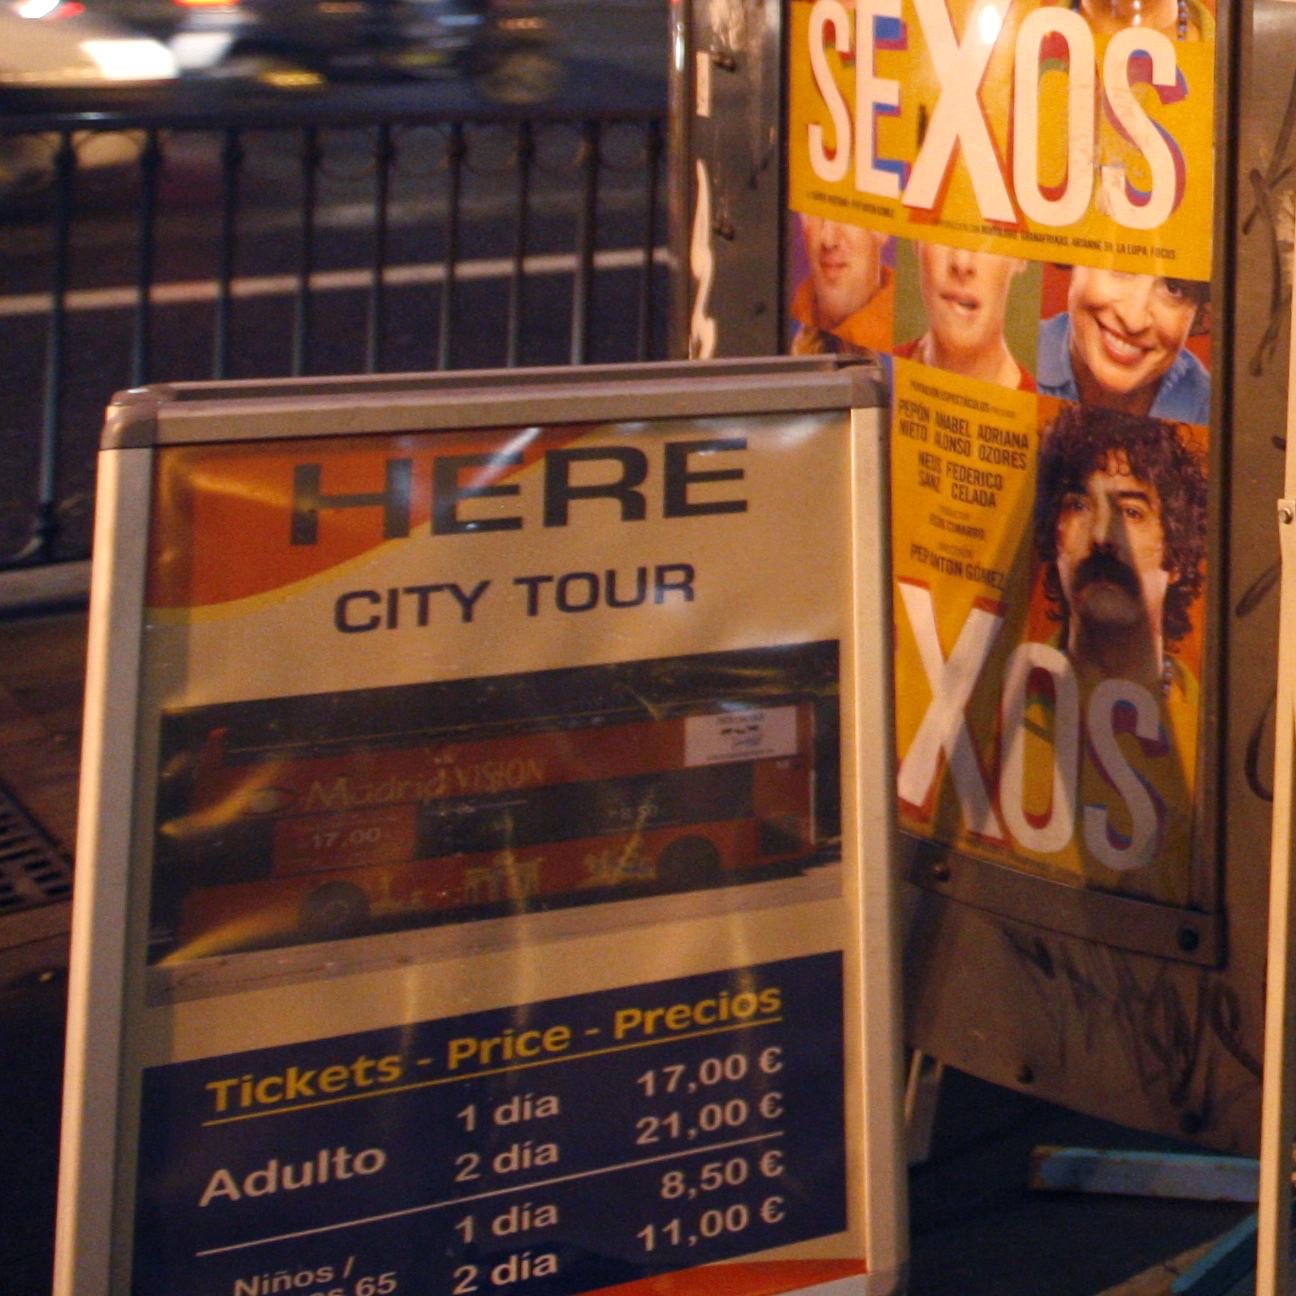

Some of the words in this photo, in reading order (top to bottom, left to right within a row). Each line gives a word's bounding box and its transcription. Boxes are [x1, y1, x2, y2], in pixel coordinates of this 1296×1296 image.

[899, 418, 929, 443] NIETO
[934, 430, 972, 458] ALONSO
[978, 443, 1028, 471] OZORES
[976, 424, 1029, 451] ADRIANA
[290, 438, 749, 547] HERE
[918, 449, 942, 475] NEUS
[946, 460, 1005, 492] FEDERICO
[951, 482, 997, 508] CELADA
[334, 580, 491, 635] CITY
[513, 563, 696, 618] TOUR
[307, 770, 449, 805] Madrid
[205, 1052, 403, 1113] Tickets
[447, 1022, 572, 1070] Price
[613, 984, 783, 1041] Precios
[458, 1106, 478, 1133] 1
[494, 1091, 561, 1128] día
[636, 1053, 749, 1101] 17,00
[757, 1045, 785, 1075] €
[455, 1153, 480, 1183] 2
[494, 1137, 560, 1175] día
[635, 1098, 749, 1147] 21,00
[757, 1091, 785, 1120] €
[198, 1146, 388, 1207] Adulto
[455, 1215, 476, 1245] 1
[491, 1200, 560, 1238] día
[660, 1159, 749, 1201] 8,50
[758, 1148, 786, 1178] €
[452, 1264, 479, 1295] 2
[491, 1250, 559, 1286] día
[636, 1202, 750, 1254] 11,00
[758, 1195, 786, 1225] €
[233, 1264, 335, 1296] Niños
[354, 1271, 398, 1296] 65
